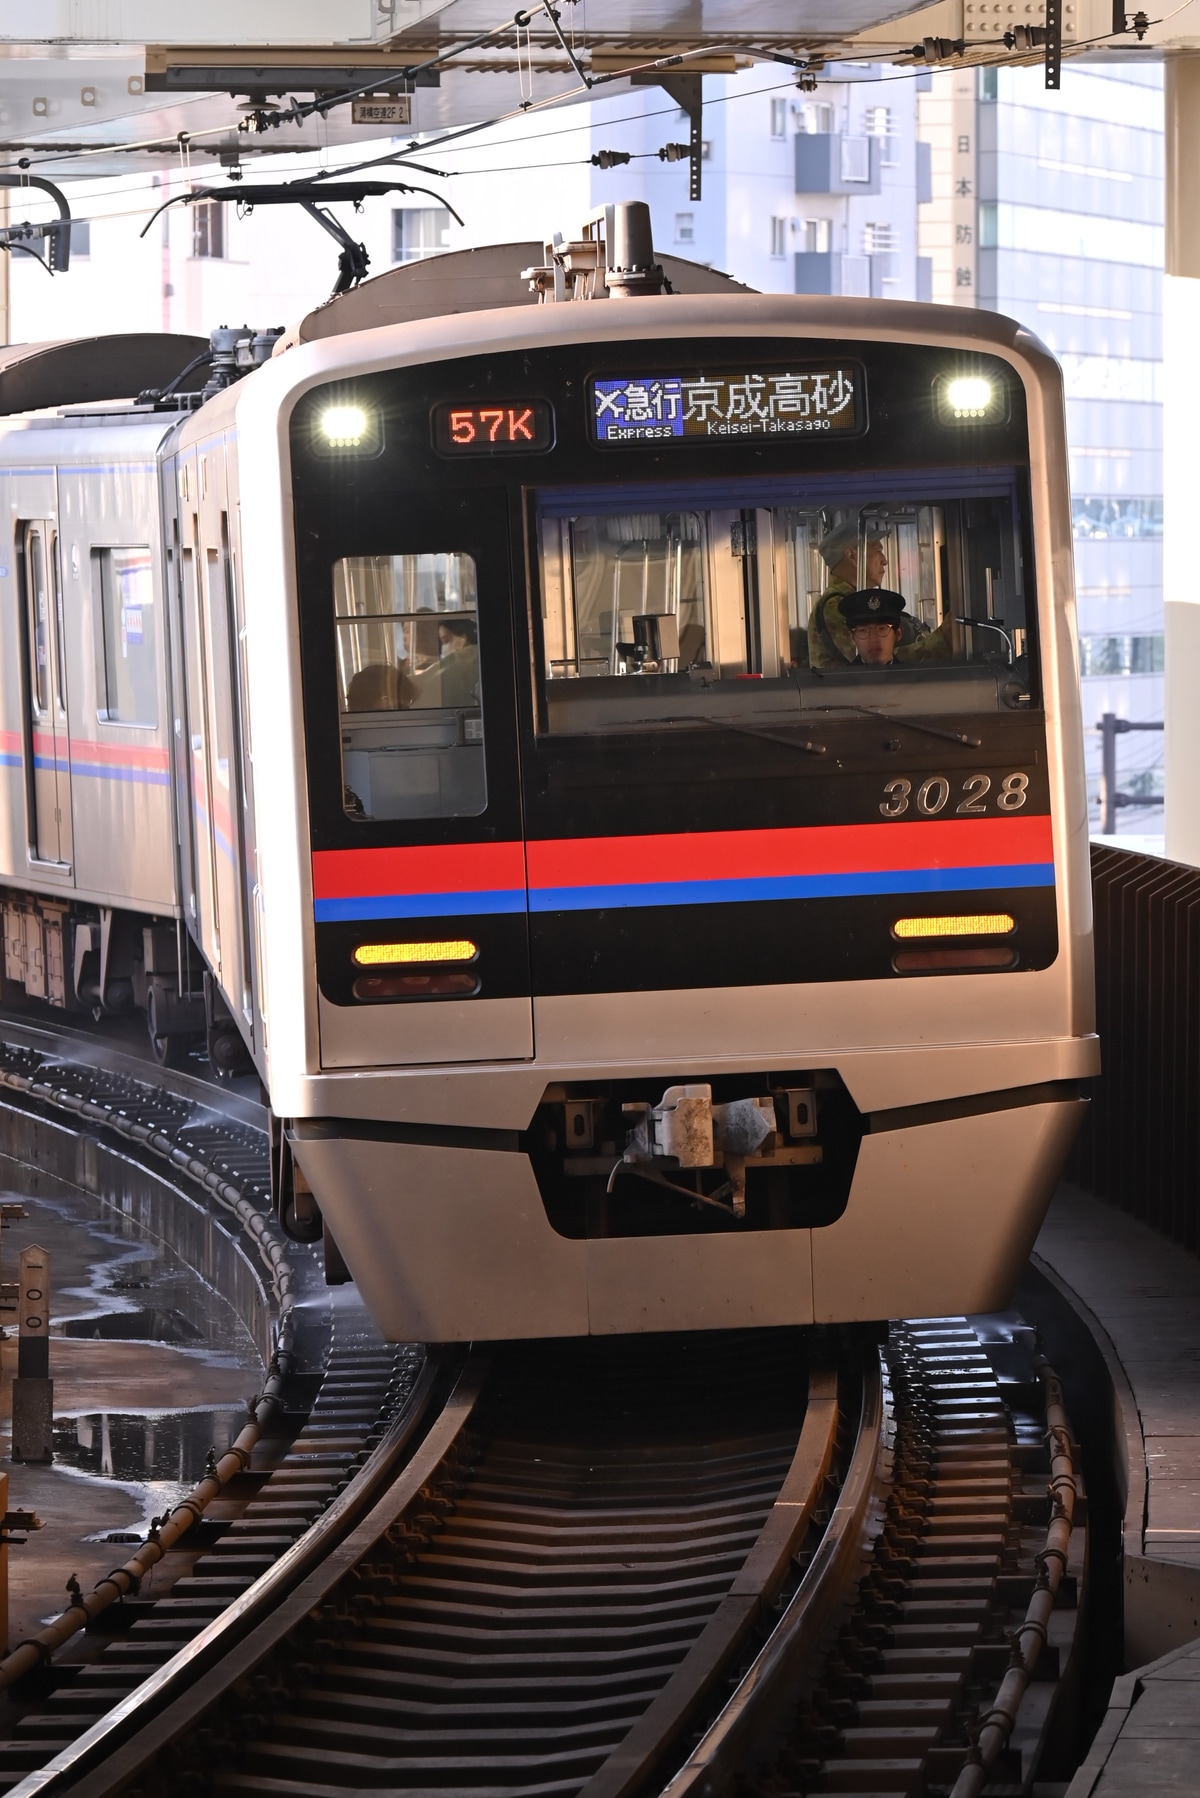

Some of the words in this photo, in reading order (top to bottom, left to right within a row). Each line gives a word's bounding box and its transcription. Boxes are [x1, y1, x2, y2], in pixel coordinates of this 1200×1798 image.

[399, 107, 403, 118] 2
[624, 382, 682, 421] 急行
[681, 370, 854, 421] 京成高砂
[451, 409, 533, 443] 57K
[607, 425, 672, 440] Express
[707, 418, 831, 436] Keisei-Takasago
[879, 772, 1029, 817] 3028
